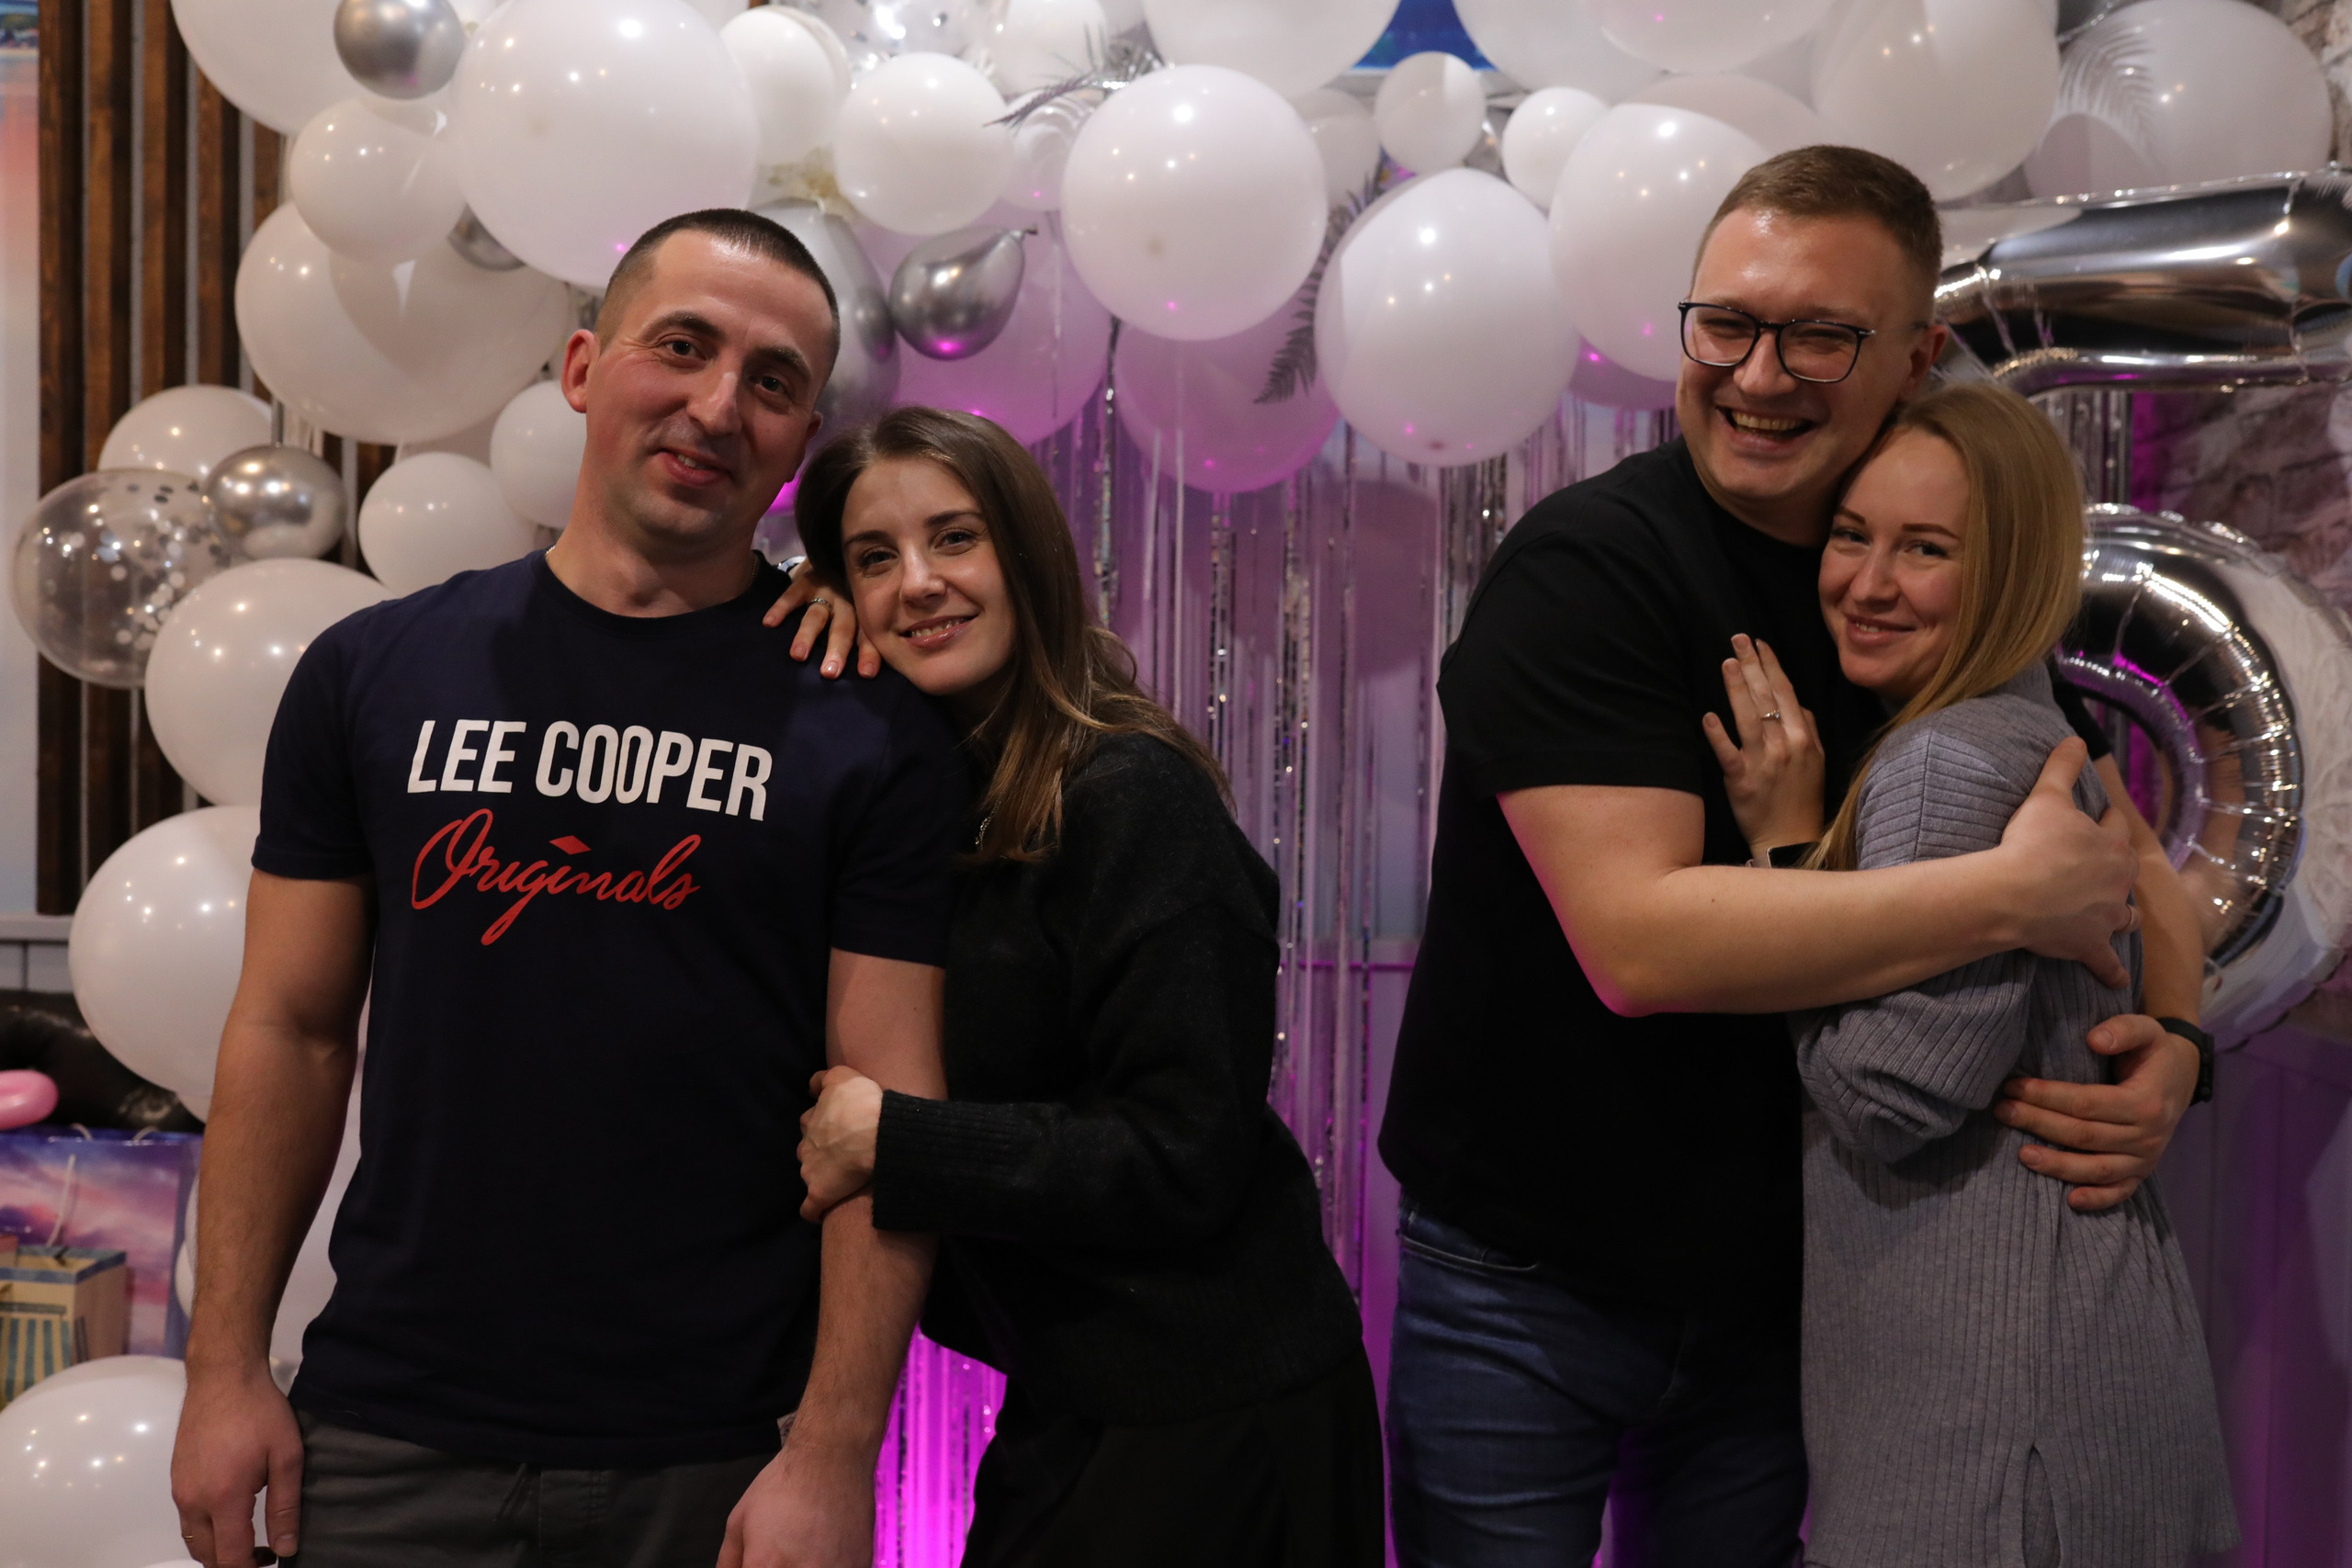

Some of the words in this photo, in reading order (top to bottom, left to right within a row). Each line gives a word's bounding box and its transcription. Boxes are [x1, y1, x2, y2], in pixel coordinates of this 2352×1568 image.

[407, 719, 527, 794] LEE
[535, 720, 774, 821] COOPER
[412, 807, 702, 946] Originals
